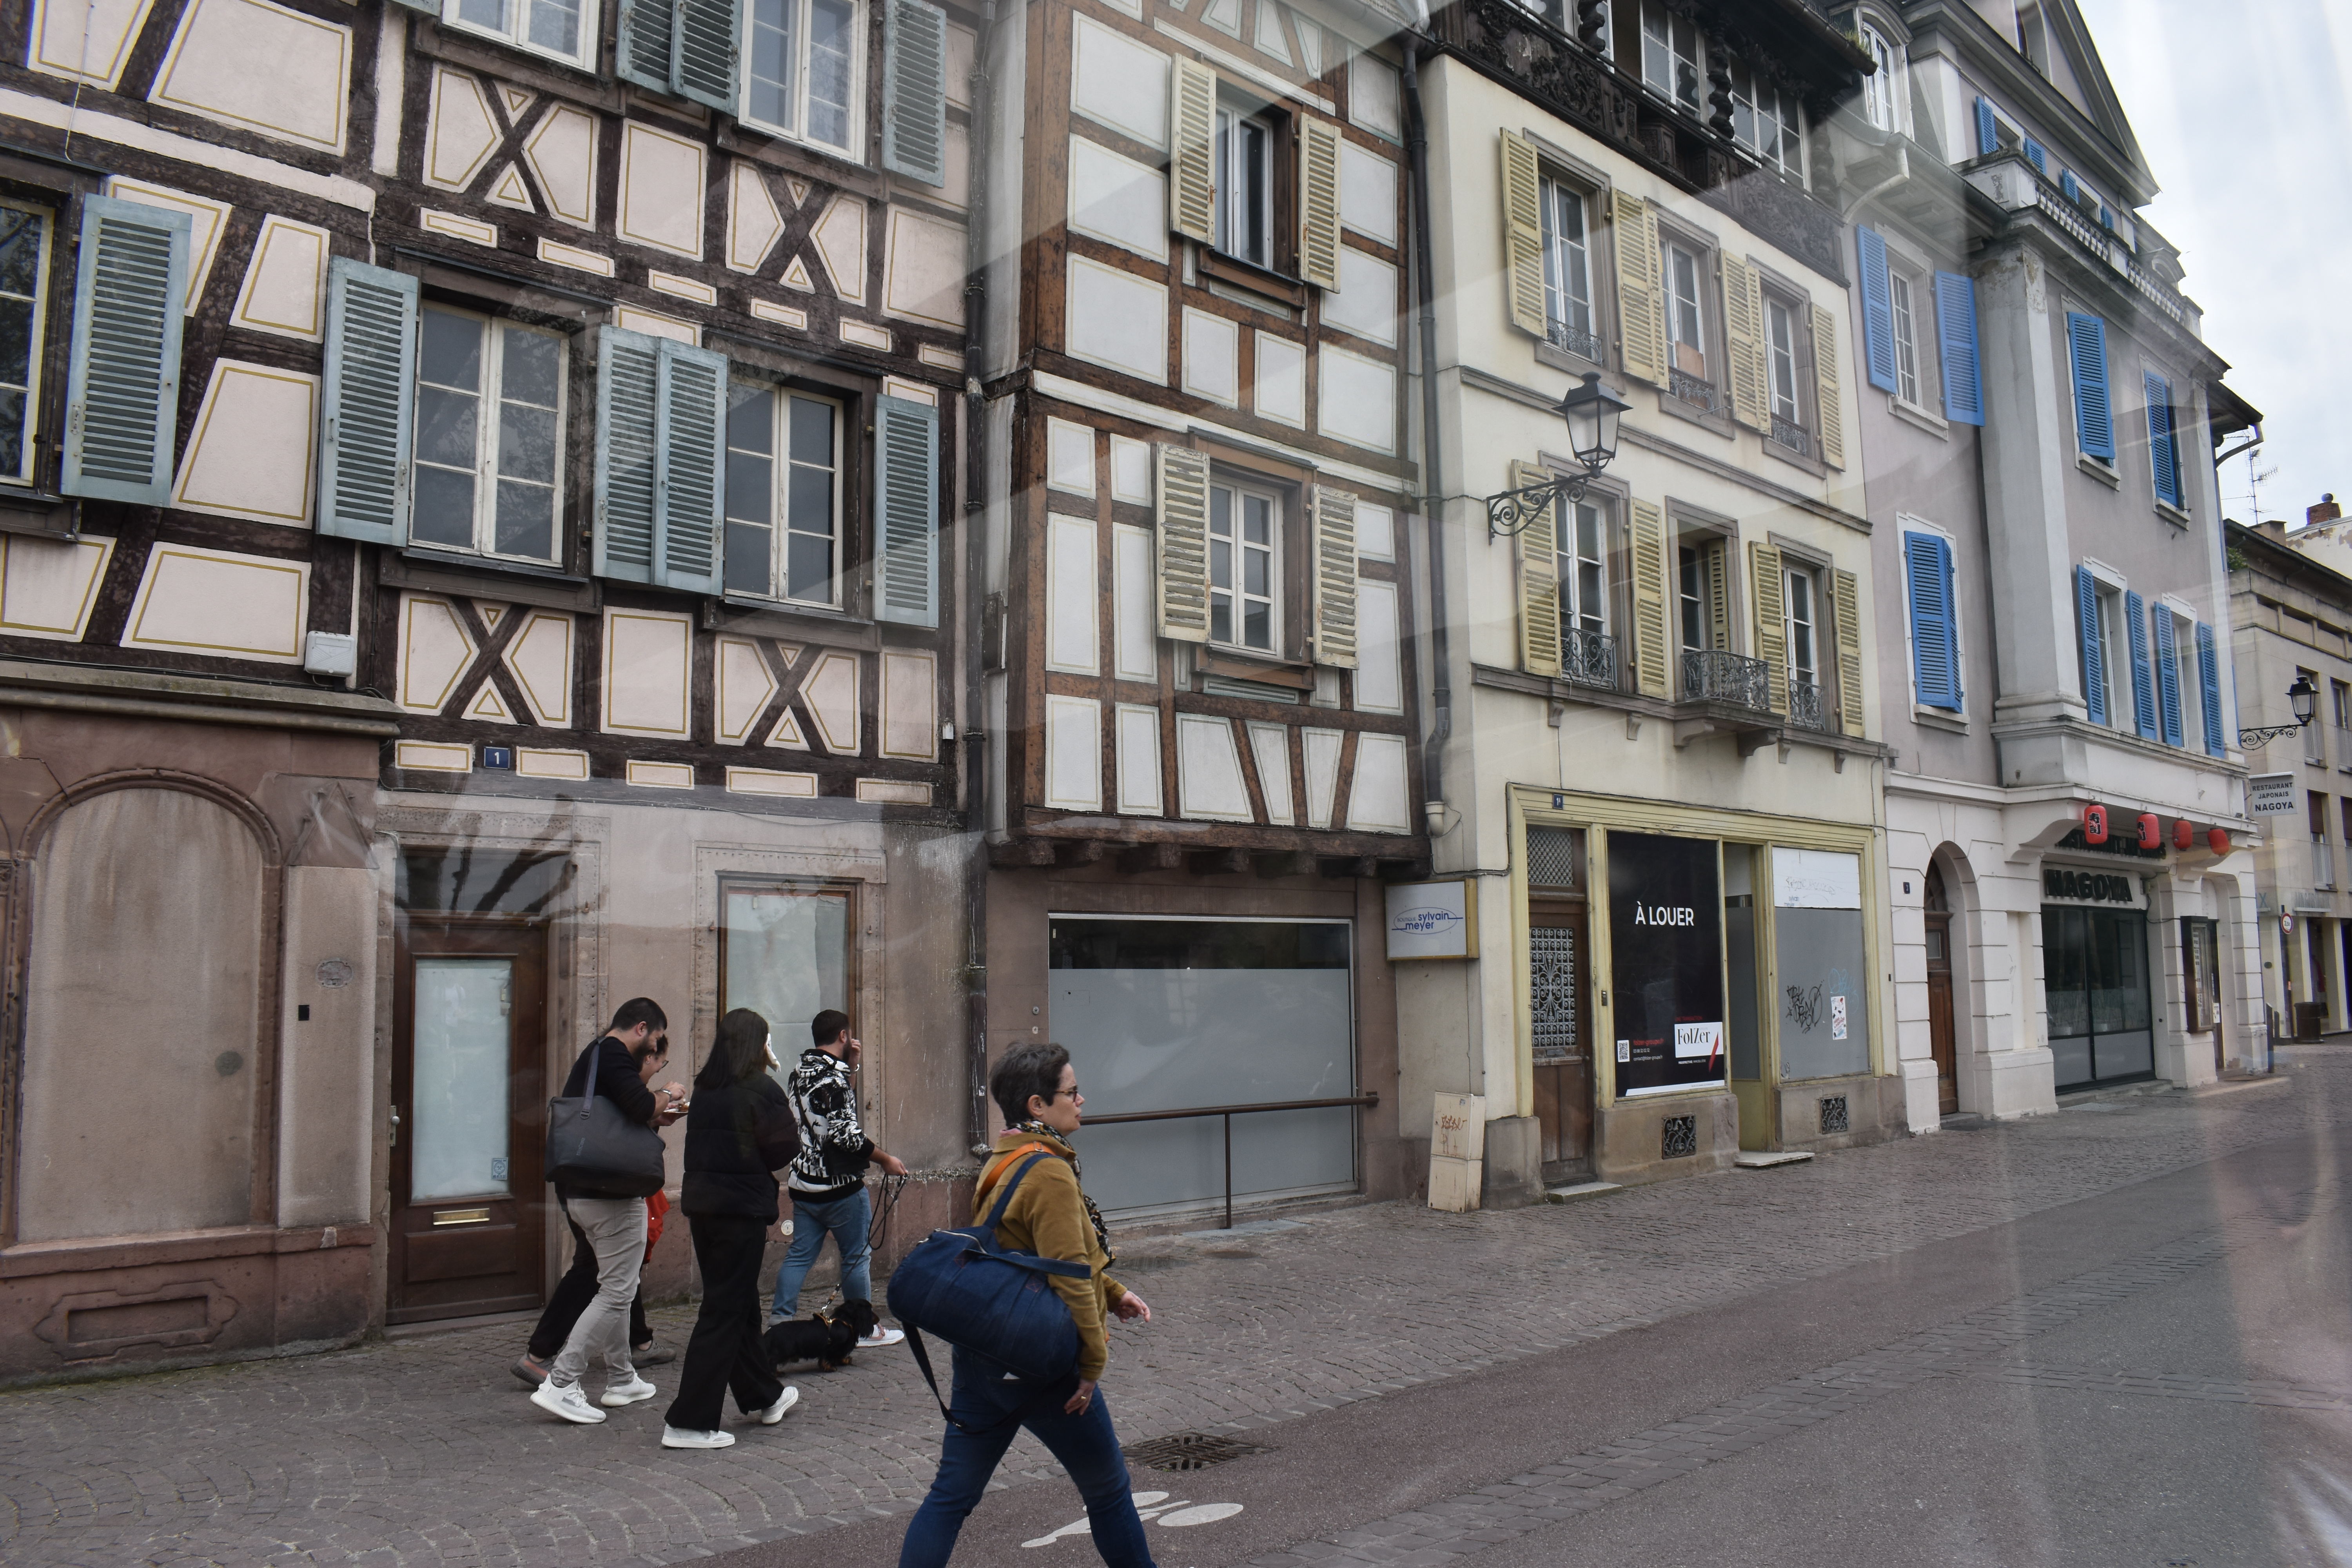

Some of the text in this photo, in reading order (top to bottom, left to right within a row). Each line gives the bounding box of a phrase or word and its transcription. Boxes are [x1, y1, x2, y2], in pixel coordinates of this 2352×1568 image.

[495, 752, 499, 764] 1
[2252, 782, 2293, 791] RESTAURANT
[2255, 801, 2294, 812] NAGOYA
[2043, 869, 2133, 902] NAGOYA
[1418, 911, 1450, 922] sylvain
[1635, 901, 1695, 926] À LOUER
[1405, 921, 1434, 931] meyer
[1677, 1027, 1711, 1045] FolZer
